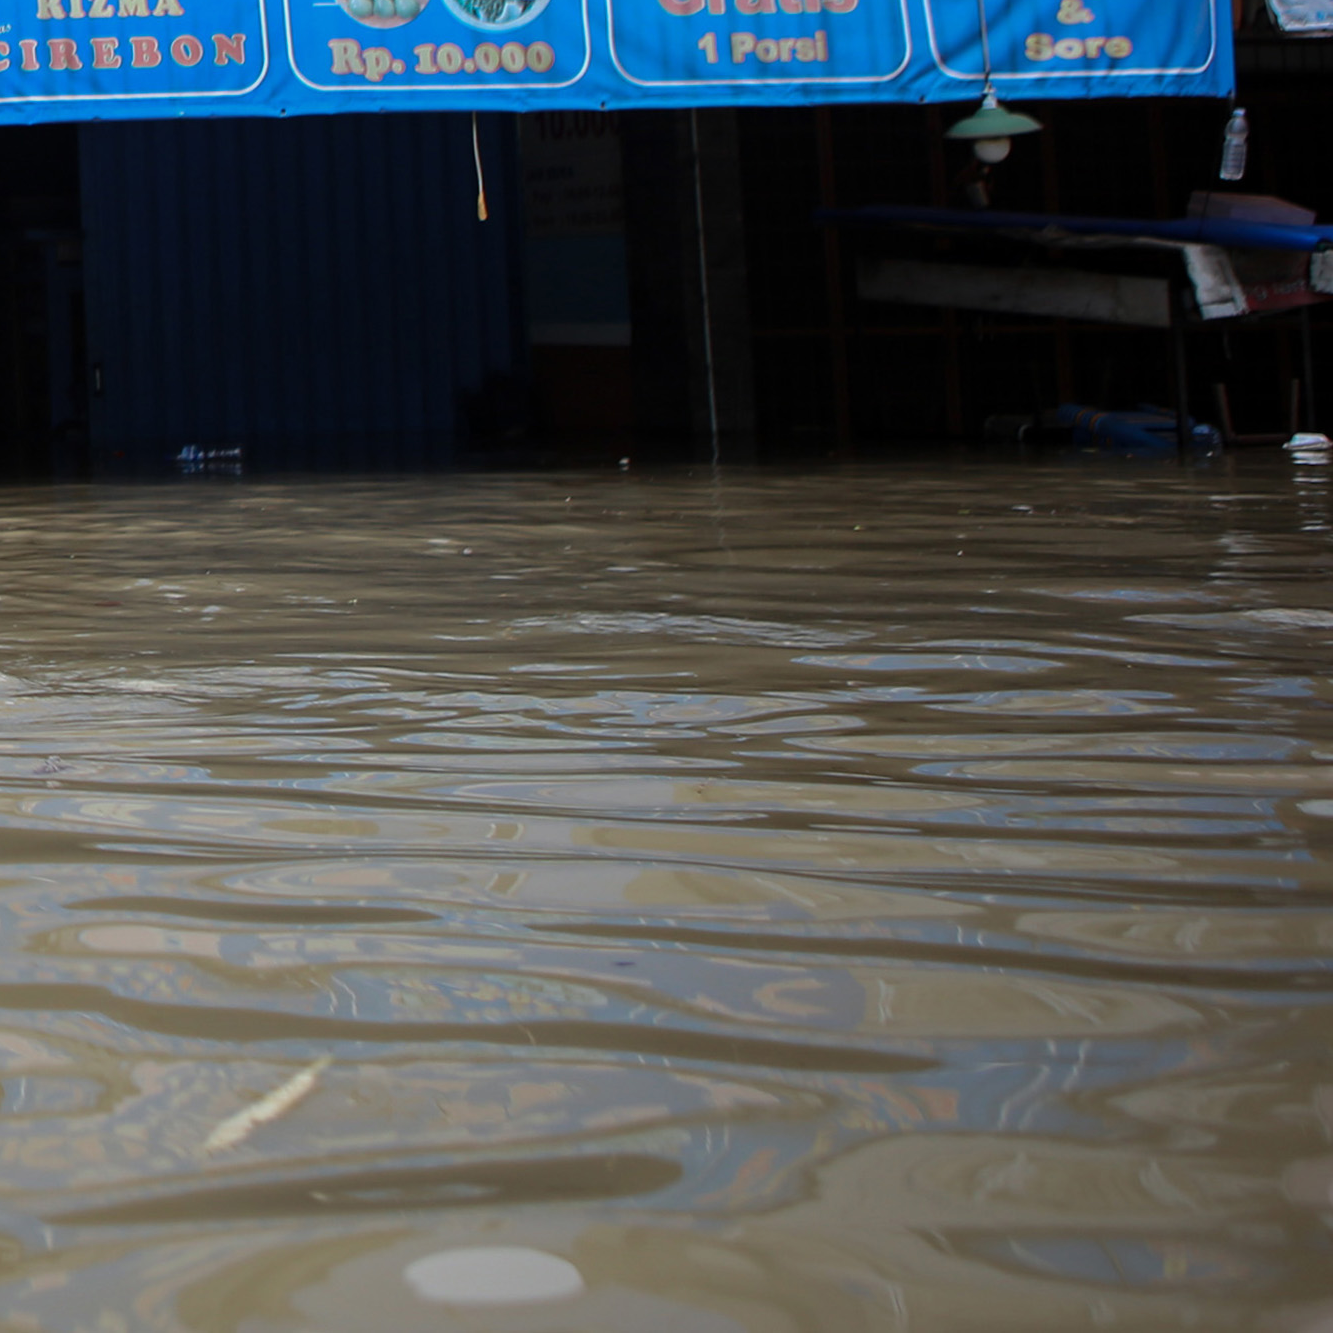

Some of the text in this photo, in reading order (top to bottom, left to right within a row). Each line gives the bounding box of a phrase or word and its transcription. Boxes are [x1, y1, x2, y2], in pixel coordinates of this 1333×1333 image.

[329, 39, 555, 82] Rp. 10.000
[697, 31, 829, 64] 1 Porsi
[1024, 34, 1133, 62] Sore
